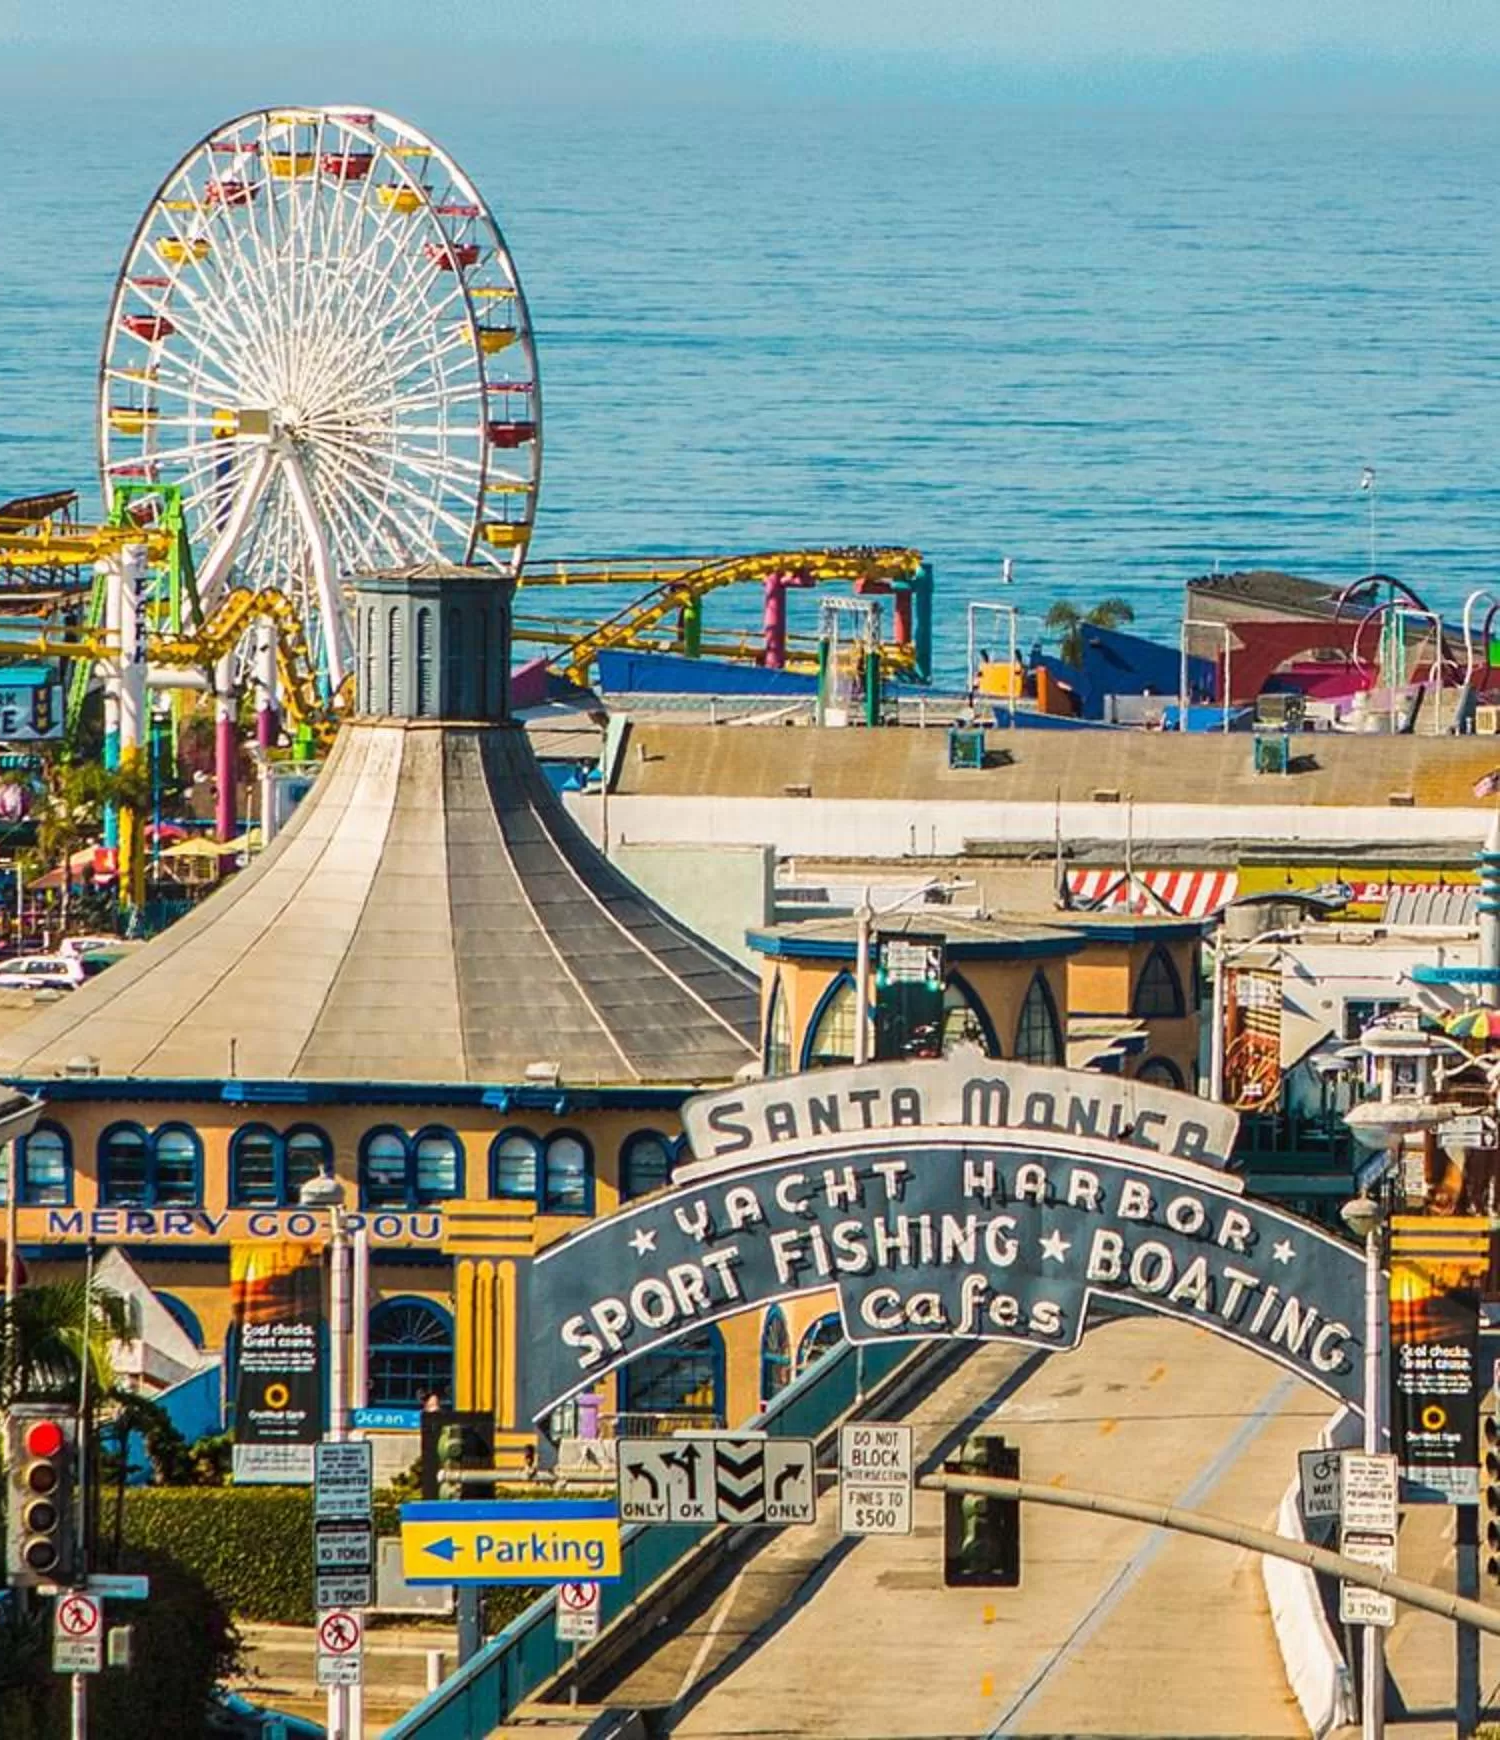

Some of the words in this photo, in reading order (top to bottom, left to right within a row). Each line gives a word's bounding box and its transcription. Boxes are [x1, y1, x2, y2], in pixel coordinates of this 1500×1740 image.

[708, 1087, 921, 1155] SANTA
[962, 1077, 1212, 1156] MONICA
[673, 1160, 907, 1242] YACHT
[963, 1158, 1252, 1251] HARBOR
[49, 1211, 228, 1235] MERRY
[560, 1245, 740, 1369] SPORT
[771, 1213, 1019, 1284] FISHING
[1087, 1228, 1352, 1372] BOATING
[355, 1410, 404, 1425] Ocean
[853, 1431, 871, 1446] DO
[876, 1432, 898, 1447] NOT
[852, 1449, 899, 1467] BLOCK
[1313, 1484, 1333, 1495] MAY
[849, 1491, 883, 1506] FINES
[889, 1492, 903, 1507] TO
[623, 1503, 665, 1517] ONLY
[680, 1503, 705, 1517] OK
[767, 1503, 810, 1517] ONLY
[855, 1509, 896, 1527] $500
[321, 1548, 333, 1560] 10
[337, 1547, 367, 1560] TONS
[476, 1532, 605, 1570] Parking
[321, 1590, 328, 1602] 3
[335, 1589, 366, 1603] TONS
